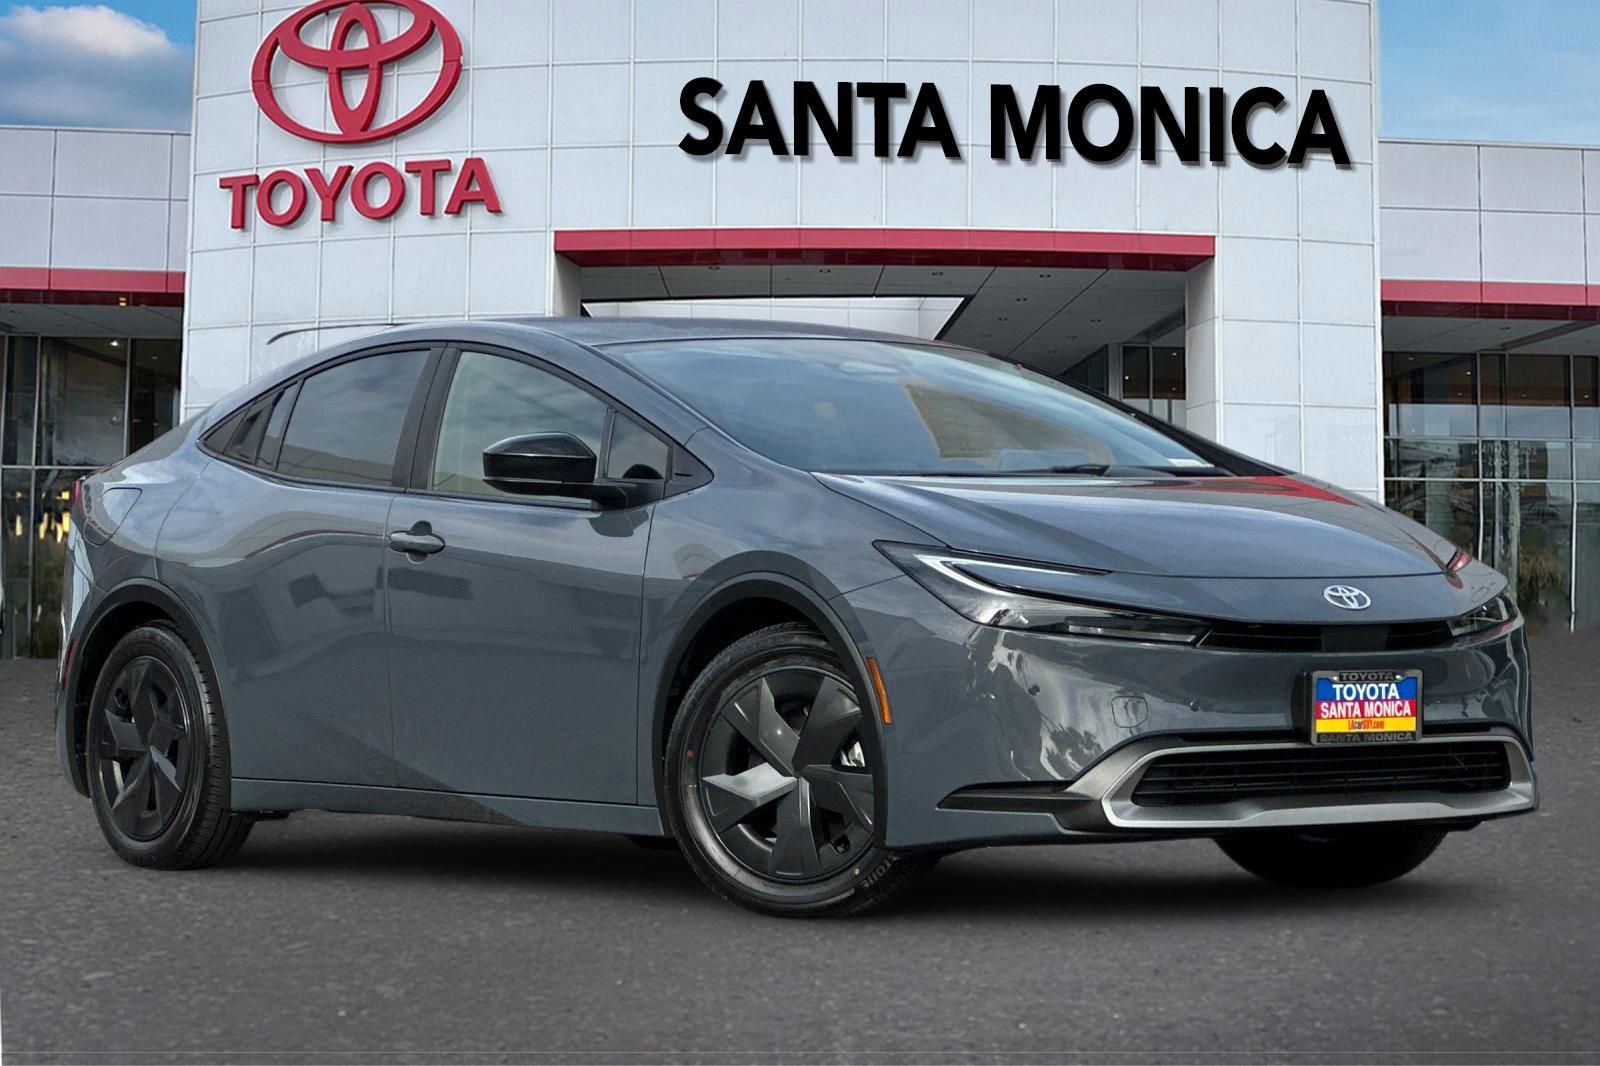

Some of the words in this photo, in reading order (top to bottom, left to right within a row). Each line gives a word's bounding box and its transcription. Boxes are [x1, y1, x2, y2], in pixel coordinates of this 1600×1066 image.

[678, 77, 961, 159] SANTA
[990, 84, 1351, 167] MONICA
[219, 157, 502, 230] TOYOTA
[1341, 672, 1394, 681] TOYOTA
[1332, 683, 1400, 700] TOYOTA
[1320, 702, 1362, 719] SANTA
[1364, 701, 1411, 717] MONICA
[1320, 733, 1360, 742] SANTA
[1363, 732, 1413, 742] MONICA
